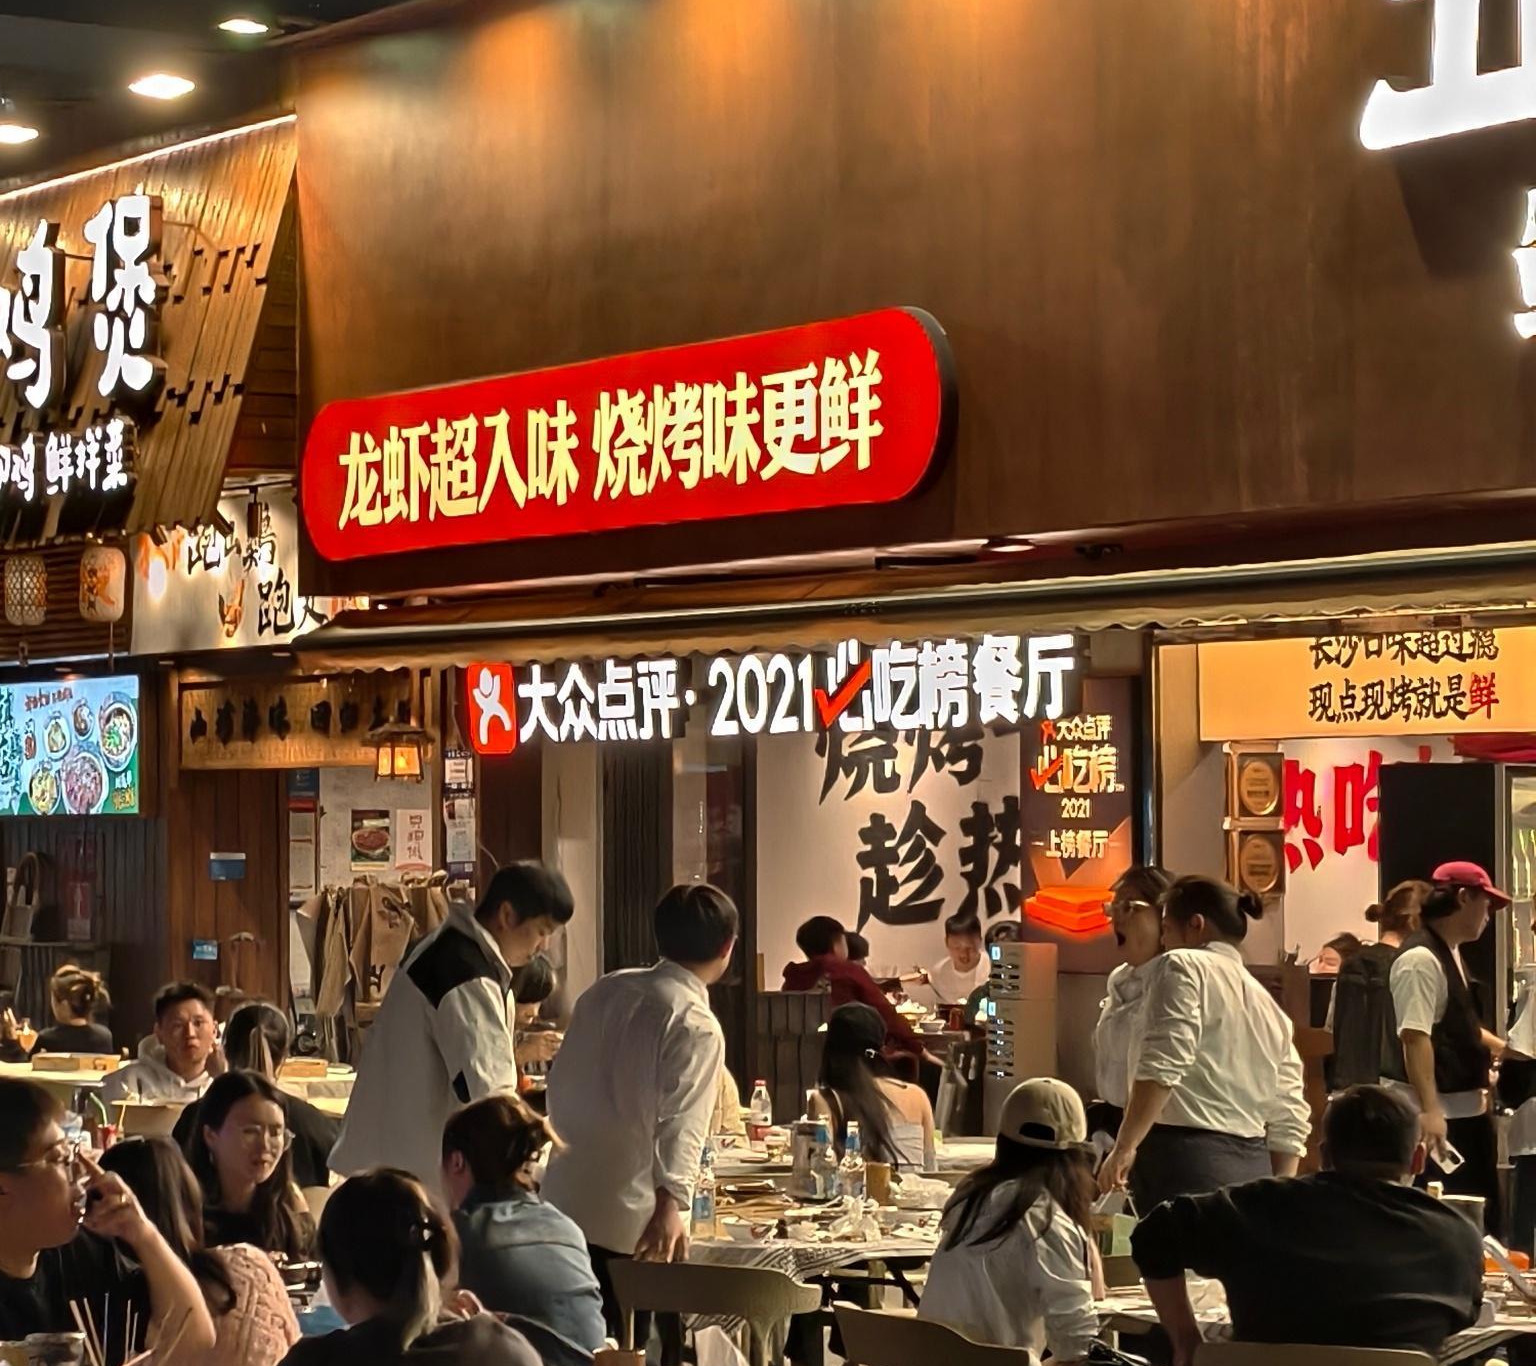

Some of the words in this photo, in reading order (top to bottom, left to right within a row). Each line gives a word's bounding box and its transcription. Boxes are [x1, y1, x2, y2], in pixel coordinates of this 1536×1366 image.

[337, 399, 580, 531] 龙虾超入味
[590, 348, 885, 501] 烧烤味更鲜
[1308, 628, 1499, 669] 长沙口味超过瘾
[1308, 672, 1500, 723] 现点现烤就是鲜
[1056, 715, 1113, 742] 大众点评
[1031, 744, 1118, 794] 必吃榜
[1060, 797, 1091, 819] 2021
[1045, 829, 1110, 859] 上榜餐厅
